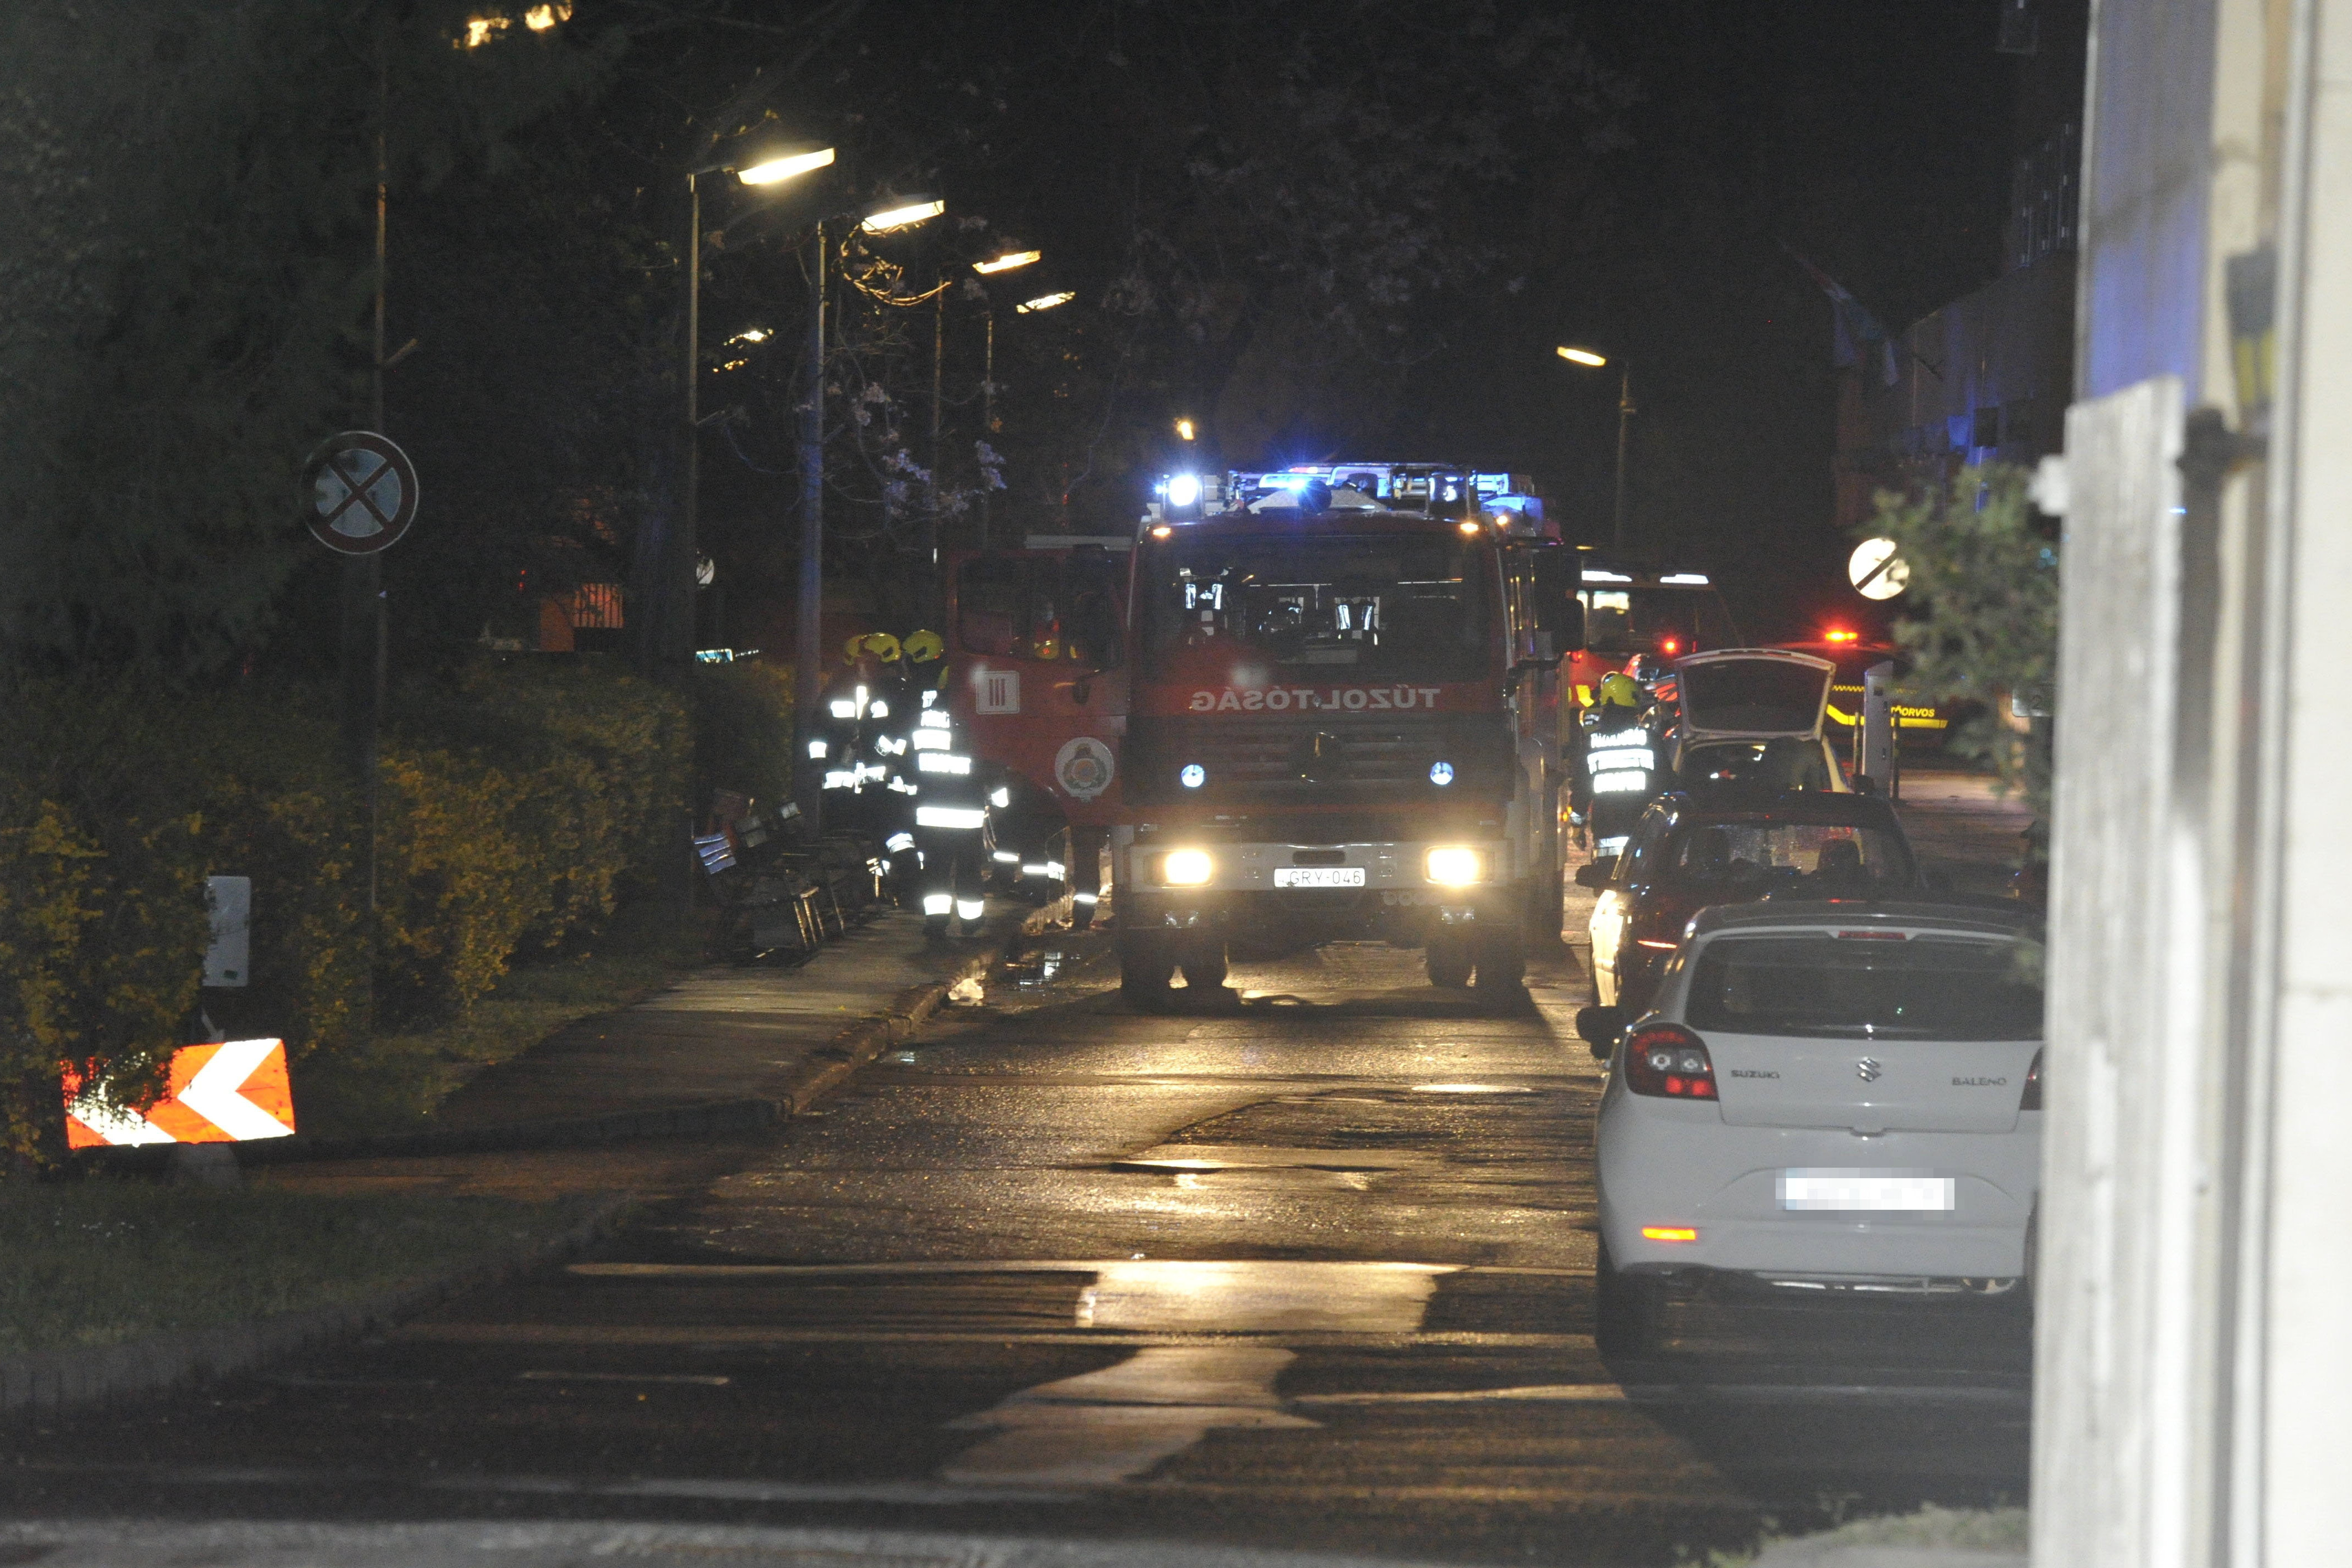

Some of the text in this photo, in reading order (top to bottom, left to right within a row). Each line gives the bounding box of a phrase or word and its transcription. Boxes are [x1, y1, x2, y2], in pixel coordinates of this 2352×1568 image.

[1290, 871, 1361, 884] GRY-046
[1731, 1070, 1780, 1079] SUZUKI
[1952, 1077, 2007, 1086] BALENO
